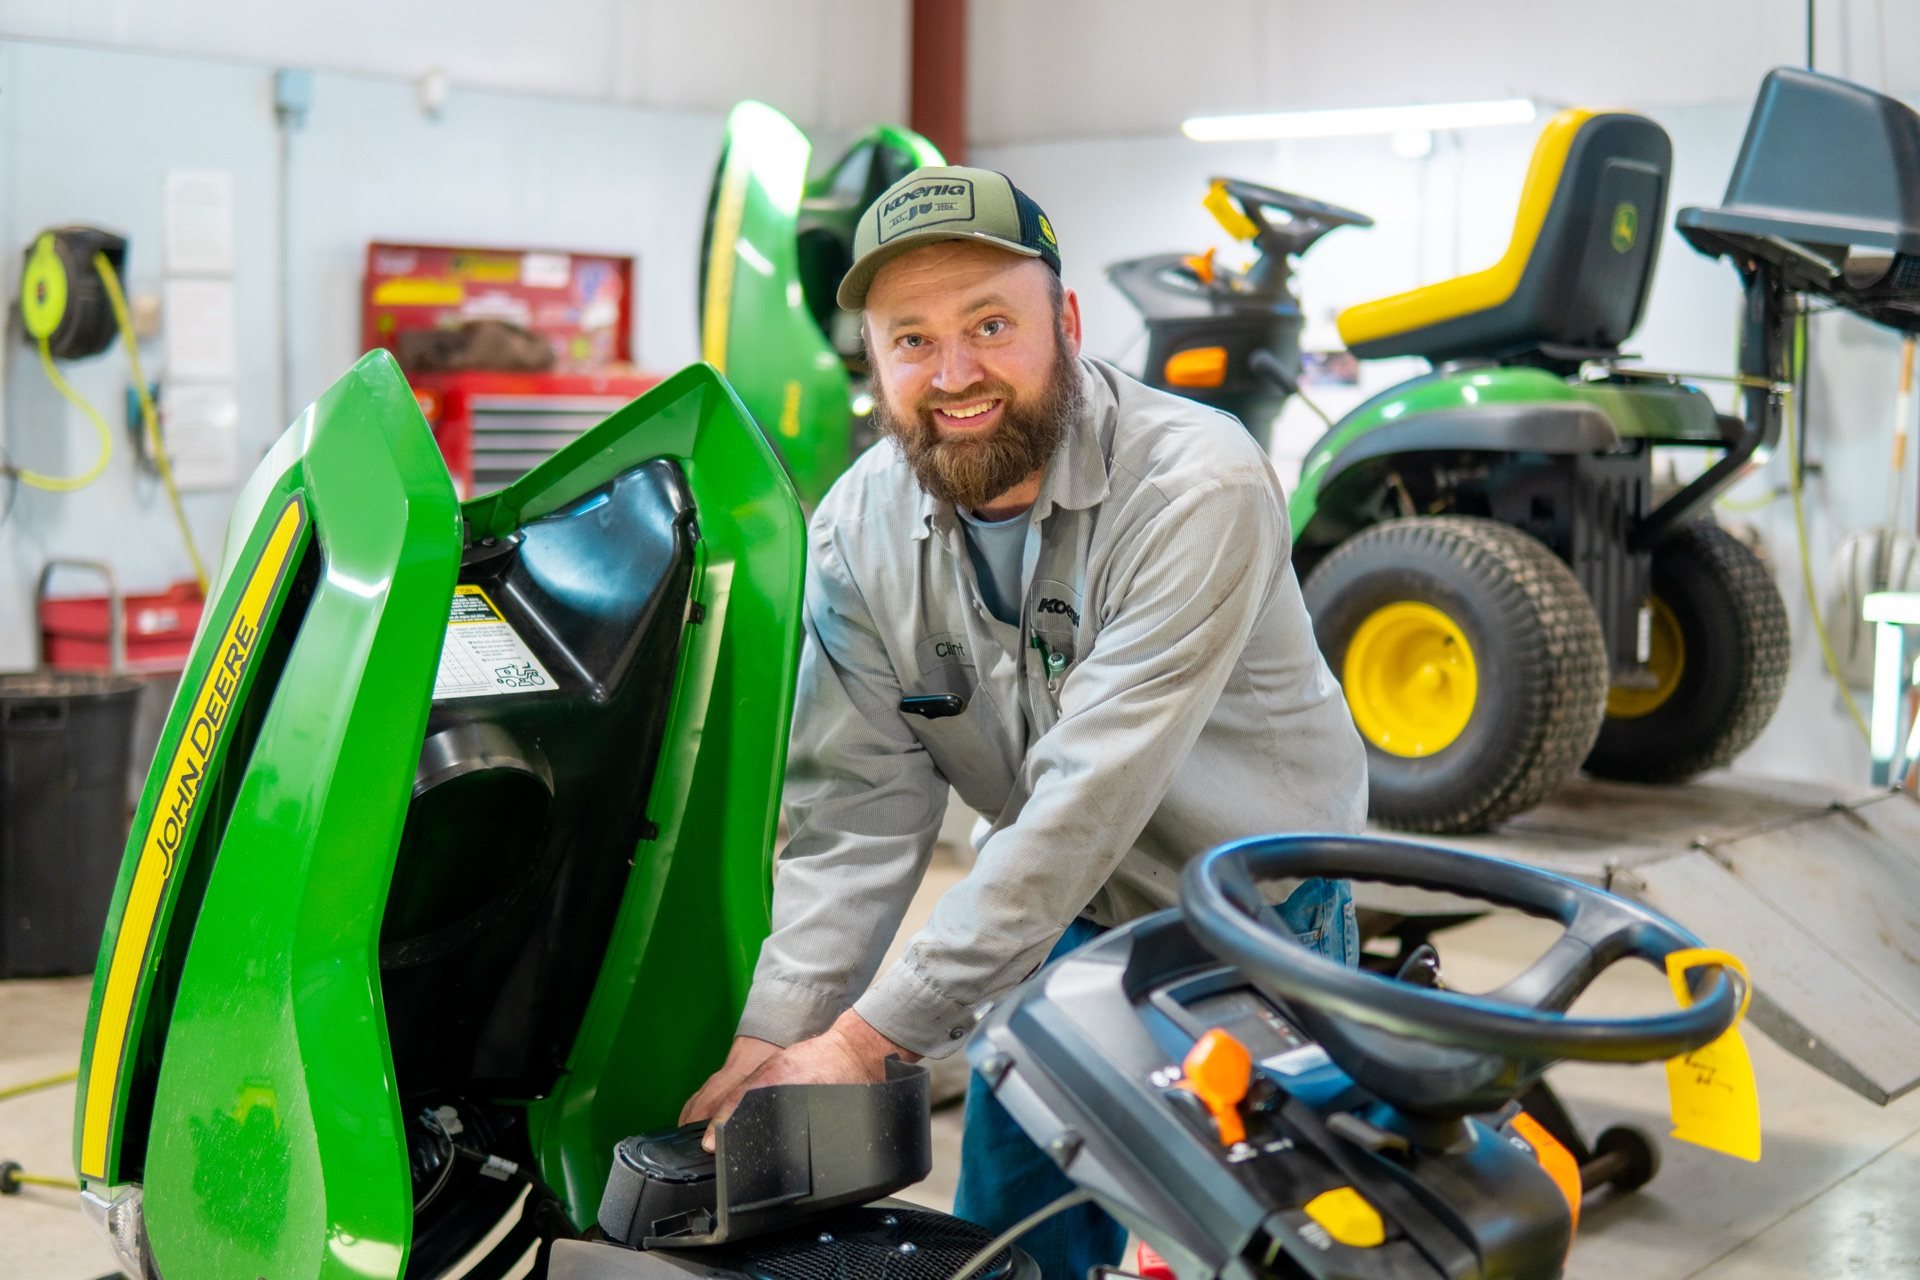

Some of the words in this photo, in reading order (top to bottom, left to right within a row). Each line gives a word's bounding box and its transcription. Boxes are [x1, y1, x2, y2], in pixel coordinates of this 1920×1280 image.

[936, 642, 965, 657] Clint
[155, 760, 203, 876] JOHN
[191, 615, 255, 757] DEERE
